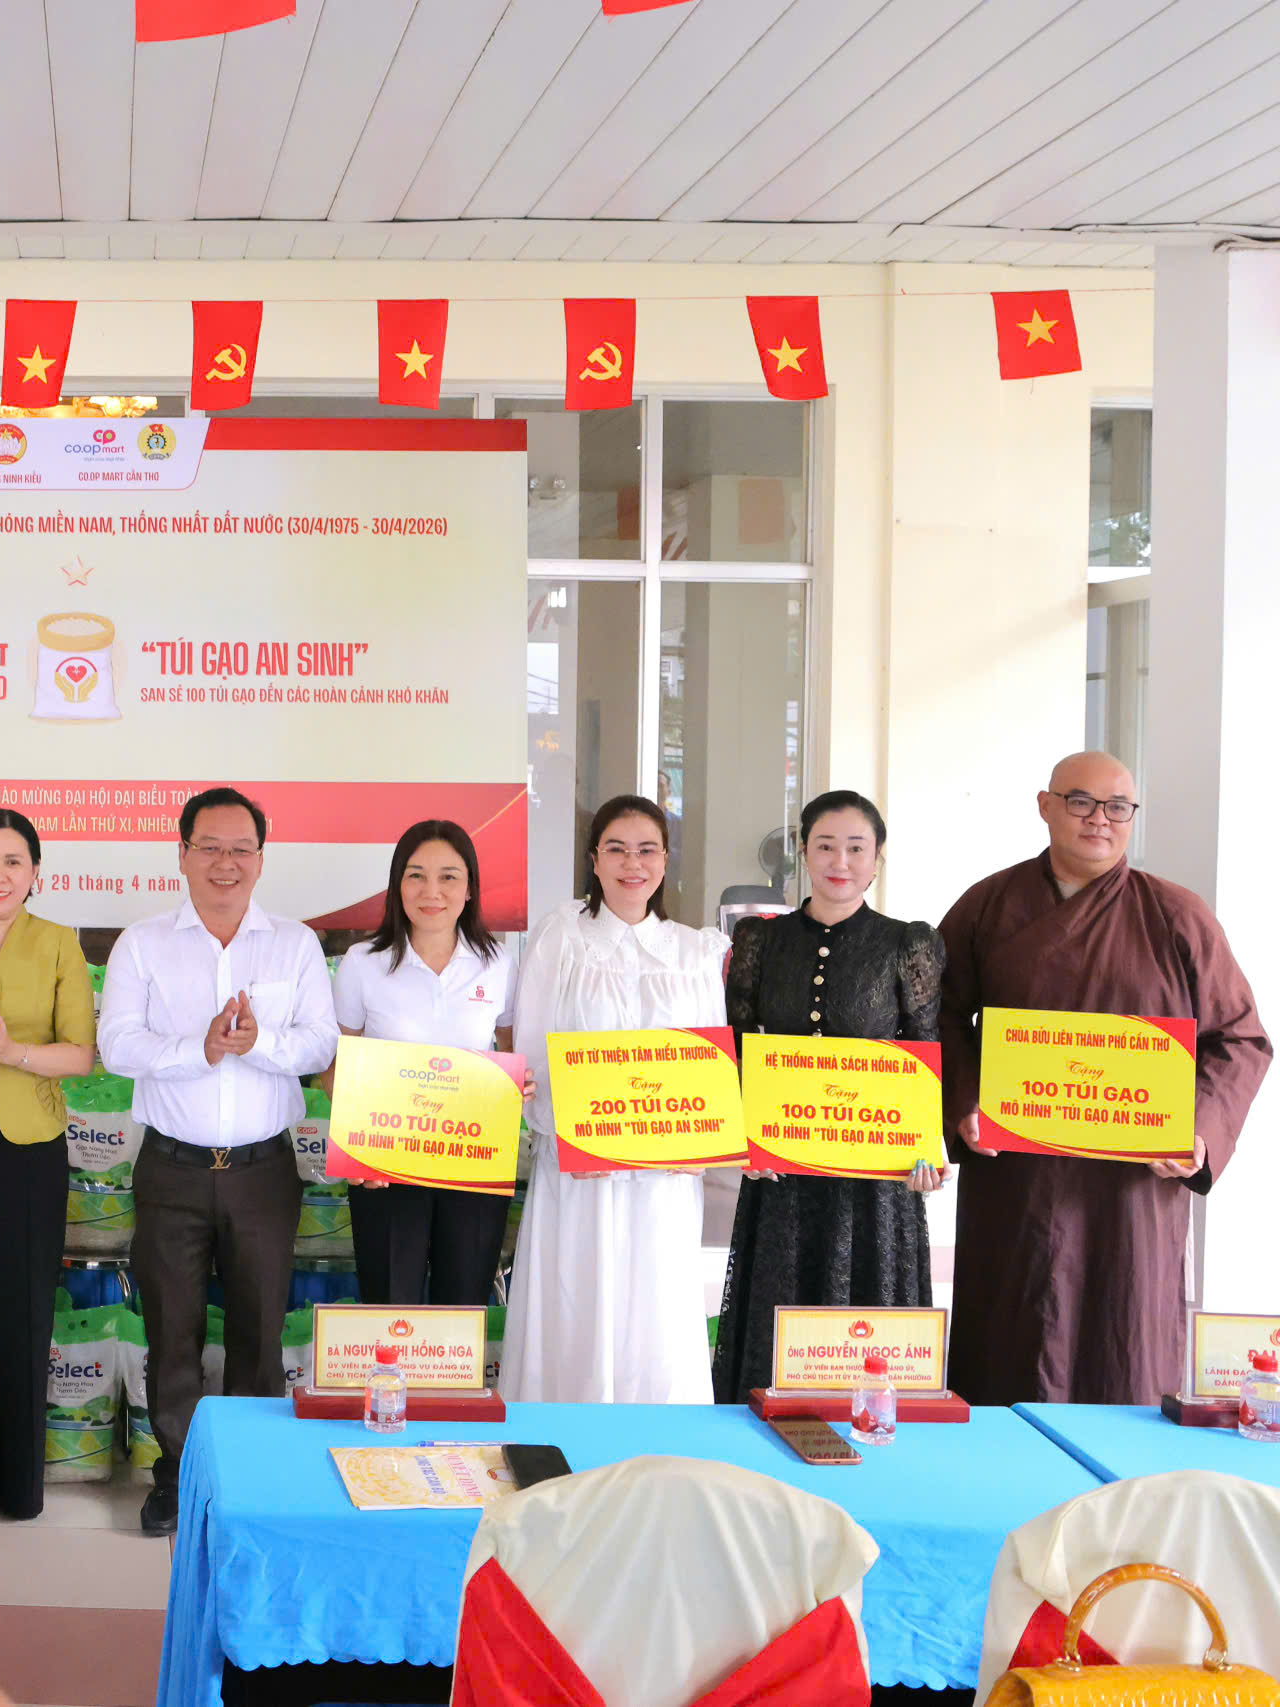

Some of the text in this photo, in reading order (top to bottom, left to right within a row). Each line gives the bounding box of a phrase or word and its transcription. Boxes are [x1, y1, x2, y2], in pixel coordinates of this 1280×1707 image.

[3, 475, 22, 483] NINH
[24, 470, 41, 484] KIỀU
[78, 468, 159, 481] CO.OP MART CẦN THƠ
[39, 509, 74, 533] MIỀN
[79, 517, 116, 536] NAM,
[120, 510, 168, 534] THỐNG
[172, 510, 209, 534] NHẤT
[214, 510, 239, 534] ĐẤT
[244, 512, 283, 534] NƯỚC
[288, 517, 359, 536] (30/4/1975
[372, 518, 448, 537] 30/4/2026)
[202, 642, 248, 680] GẠO
[256, 642, 288, 676] AN
[141, 683, 448, 705] SAN SẺ 100 TÚI GẠO ĐẾN CÁC HOÀN CẢNH KHÓ KHĂN
[22, 787, 61, 805] MỪNG
[65, 790, 85, 808] ĐẠI
[89, 787, 110, 809] HỘI
[114, 790, 135, 809] ĐẠI
[139, 784, 166, 806] BIỂU
[63, 811, 135, 833] LẦN THỨ XI,
[52, 875, 180, 894] 29 tháng 4 năm
[1006, 1026, 1170, 1052] CHÙA BỬU LIÊN THÀNH PHỐ CẦN THƠ
[566, 1043, 718, 1066] QUỸ TỪ THIỆN TÂM HIẾU THƯƠNG
[766, 1051, 917, 1074] HỆ THỐNG NHÀ SÁCH HỒNG ÂN
[1022, 1081, 1149, 1106] 100 TÚI GẠO
[590, 1095, 705, 1115] 200 TÚI GẠO
[67, 1125, 125, 1145] Select
[328, 1345, 339, 1356] BÀ
[412, 1339, 473, 1357] HỒNG NGA
[788, 1341, 858, 1359] ÔNG NGUYỄN
